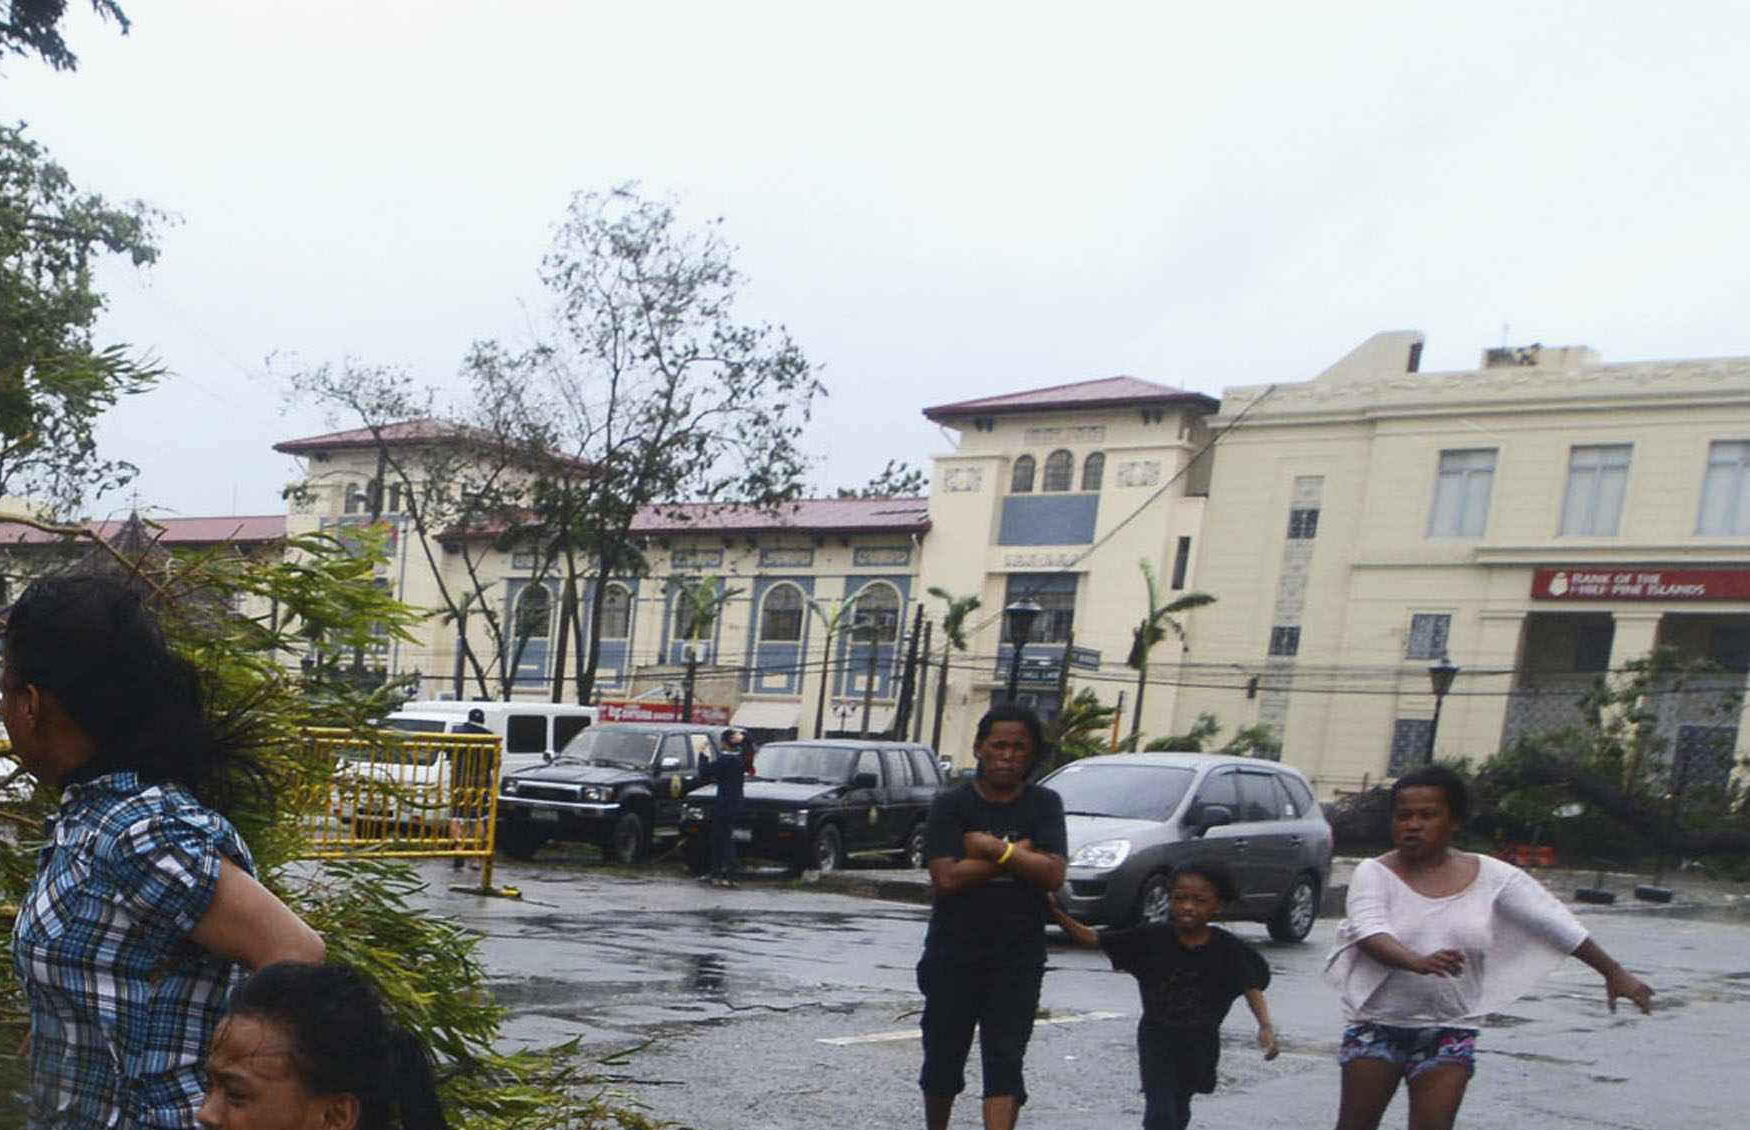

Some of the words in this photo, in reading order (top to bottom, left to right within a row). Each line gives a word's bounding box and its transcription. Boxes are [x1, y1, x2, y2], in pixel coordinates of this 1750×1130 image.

[1572, 573, 1612, 584] BANK
[1614, 573, 1633, 584] OF
[1637, 573, 1663, 584] THE
[1646, 584, 1706, 596] ISLANDS
